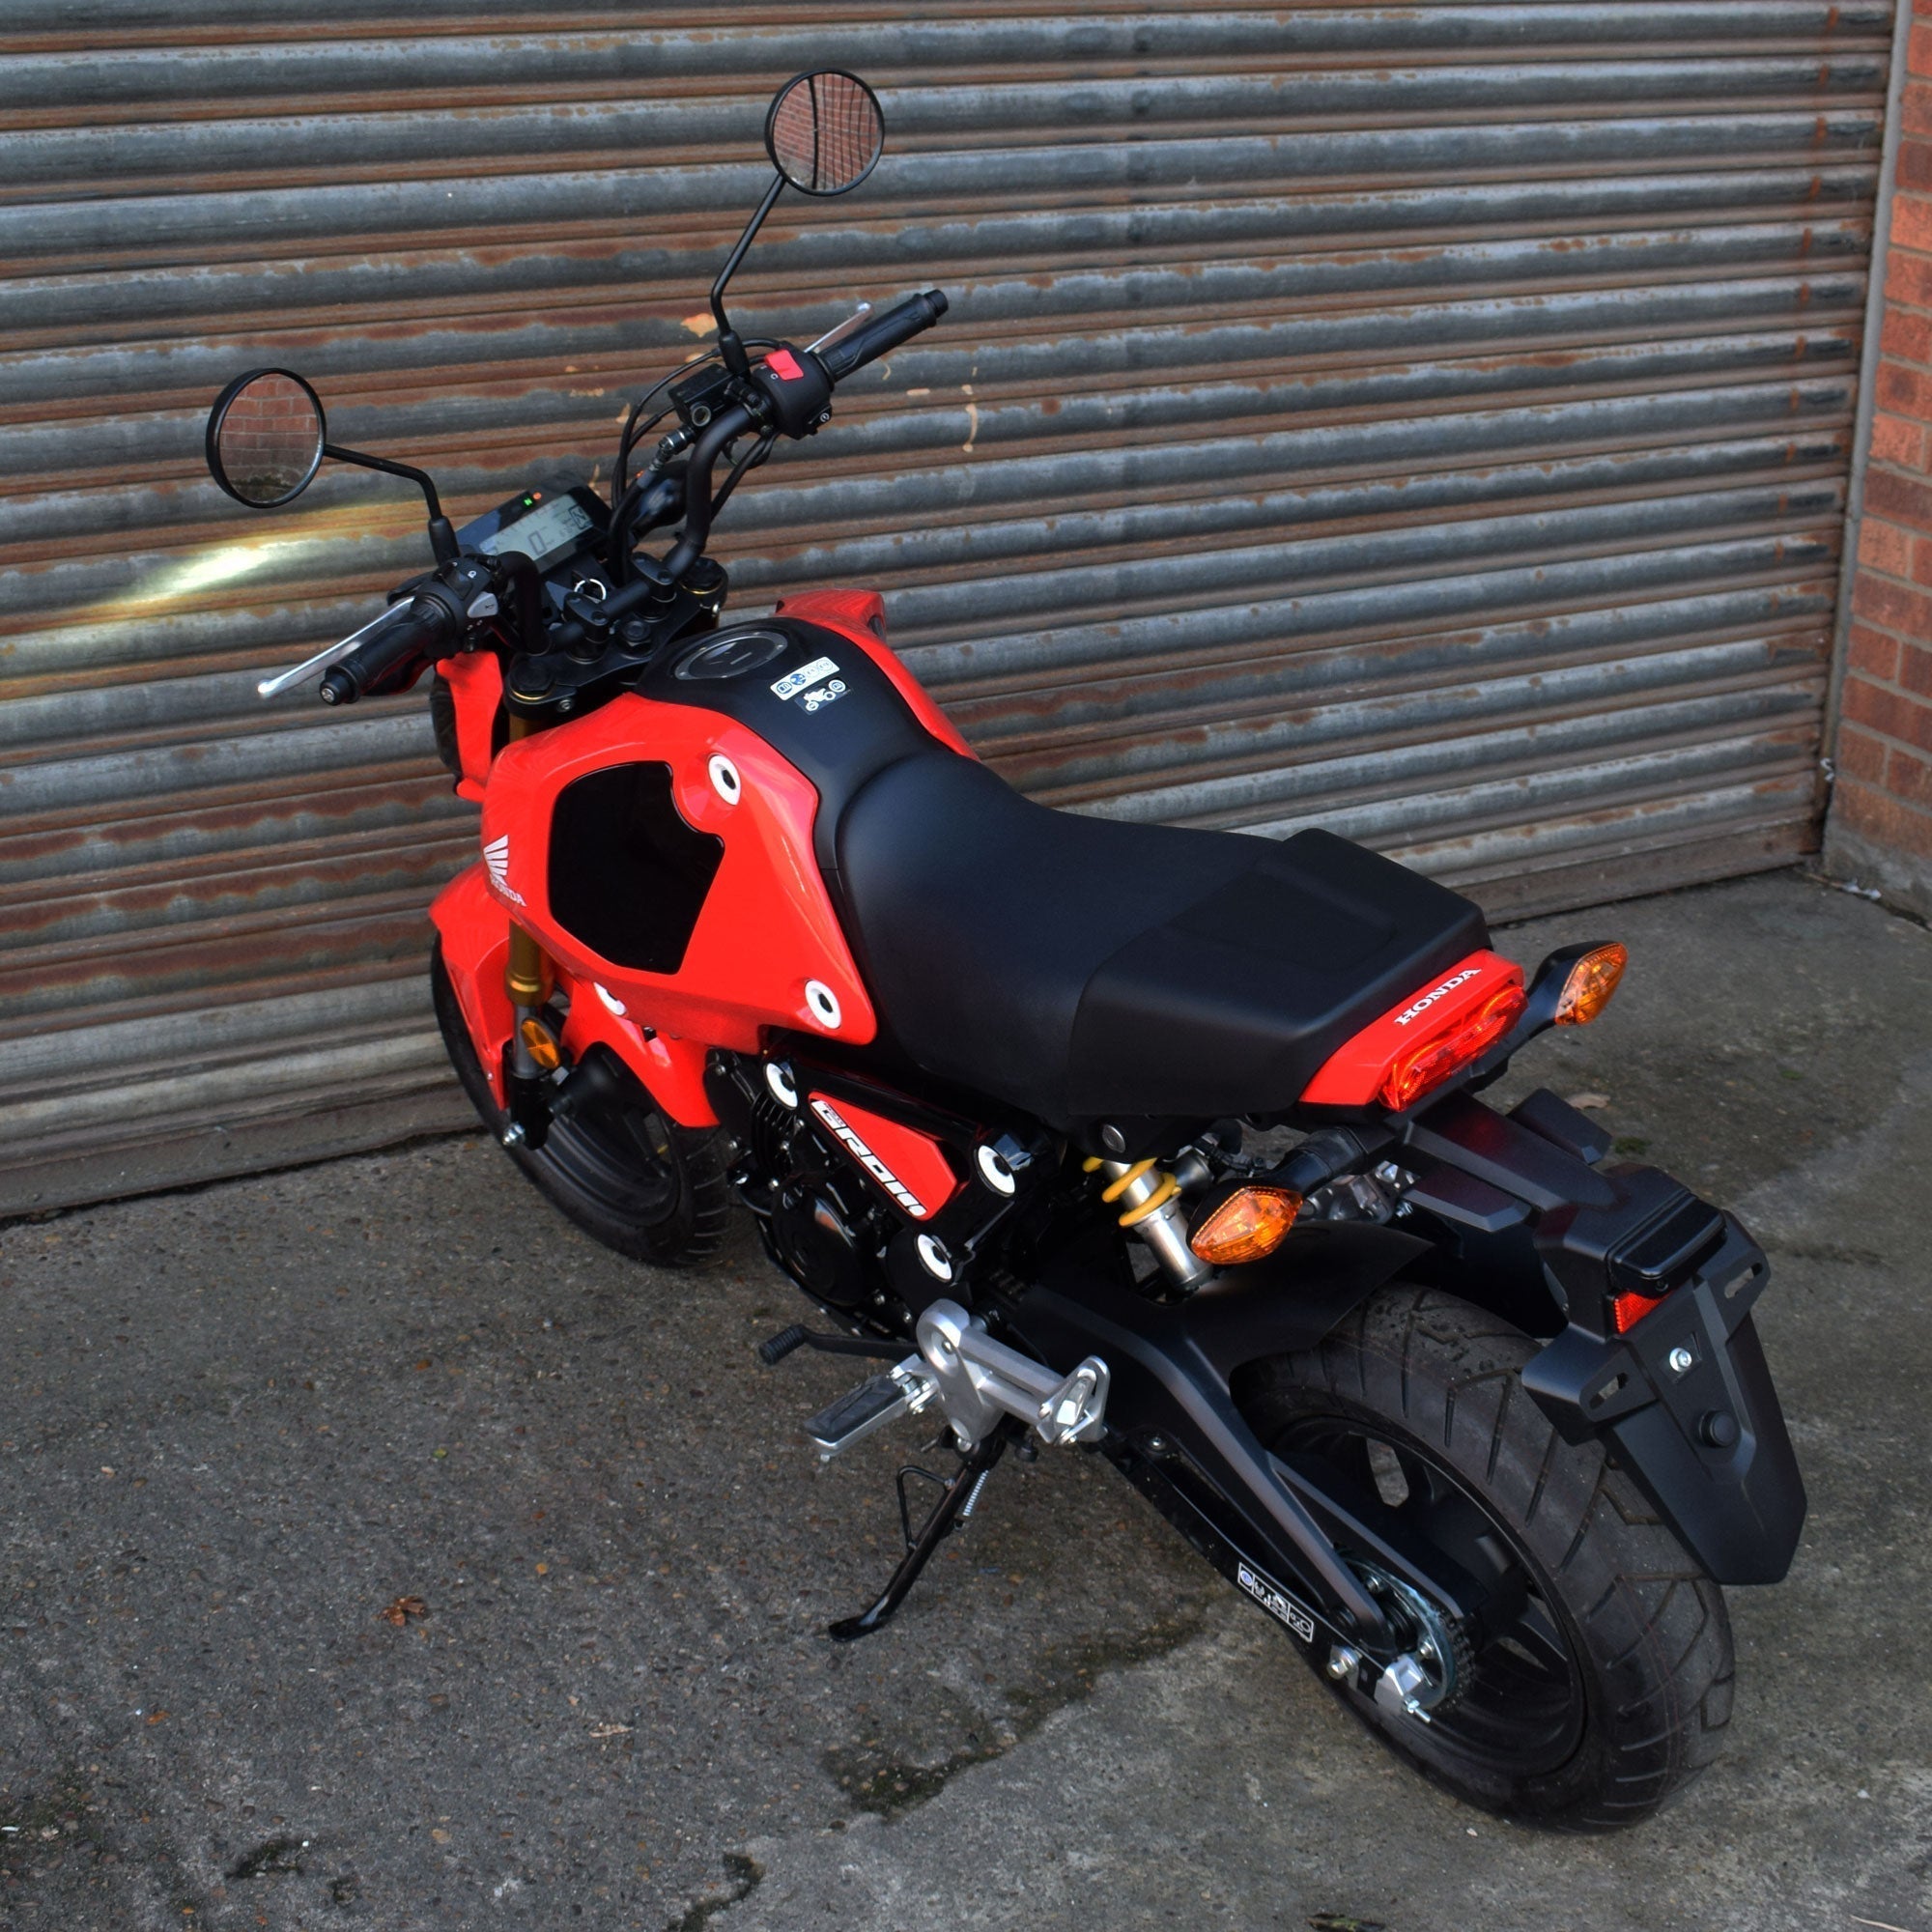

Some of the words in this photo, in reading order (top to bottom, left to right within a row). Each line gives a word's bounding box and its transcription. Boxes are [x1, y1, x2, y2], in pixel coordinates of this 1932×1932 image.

[490, 874, 527, 907] HONDA
[1394, 969, 1482, 1025] HONDA
[811, 1100, 927, 1216] GROM
